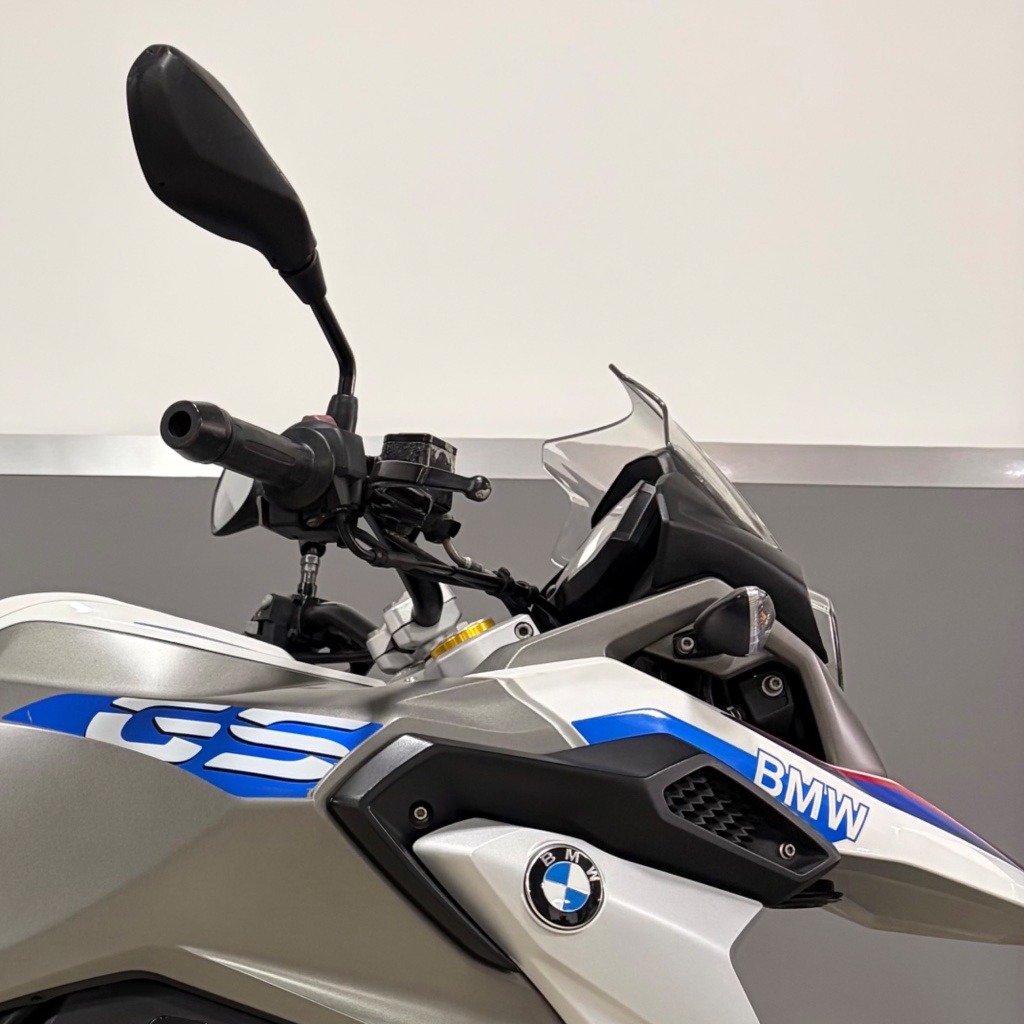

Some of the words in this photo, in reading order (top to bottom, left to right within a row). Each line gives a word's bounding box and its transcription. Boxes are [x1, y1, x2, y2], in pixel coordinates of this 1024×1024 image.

[83, 696, 371, 782] GS
[753, 747, 870, 843] BMW
[539, 848, 601, 882] BMW
